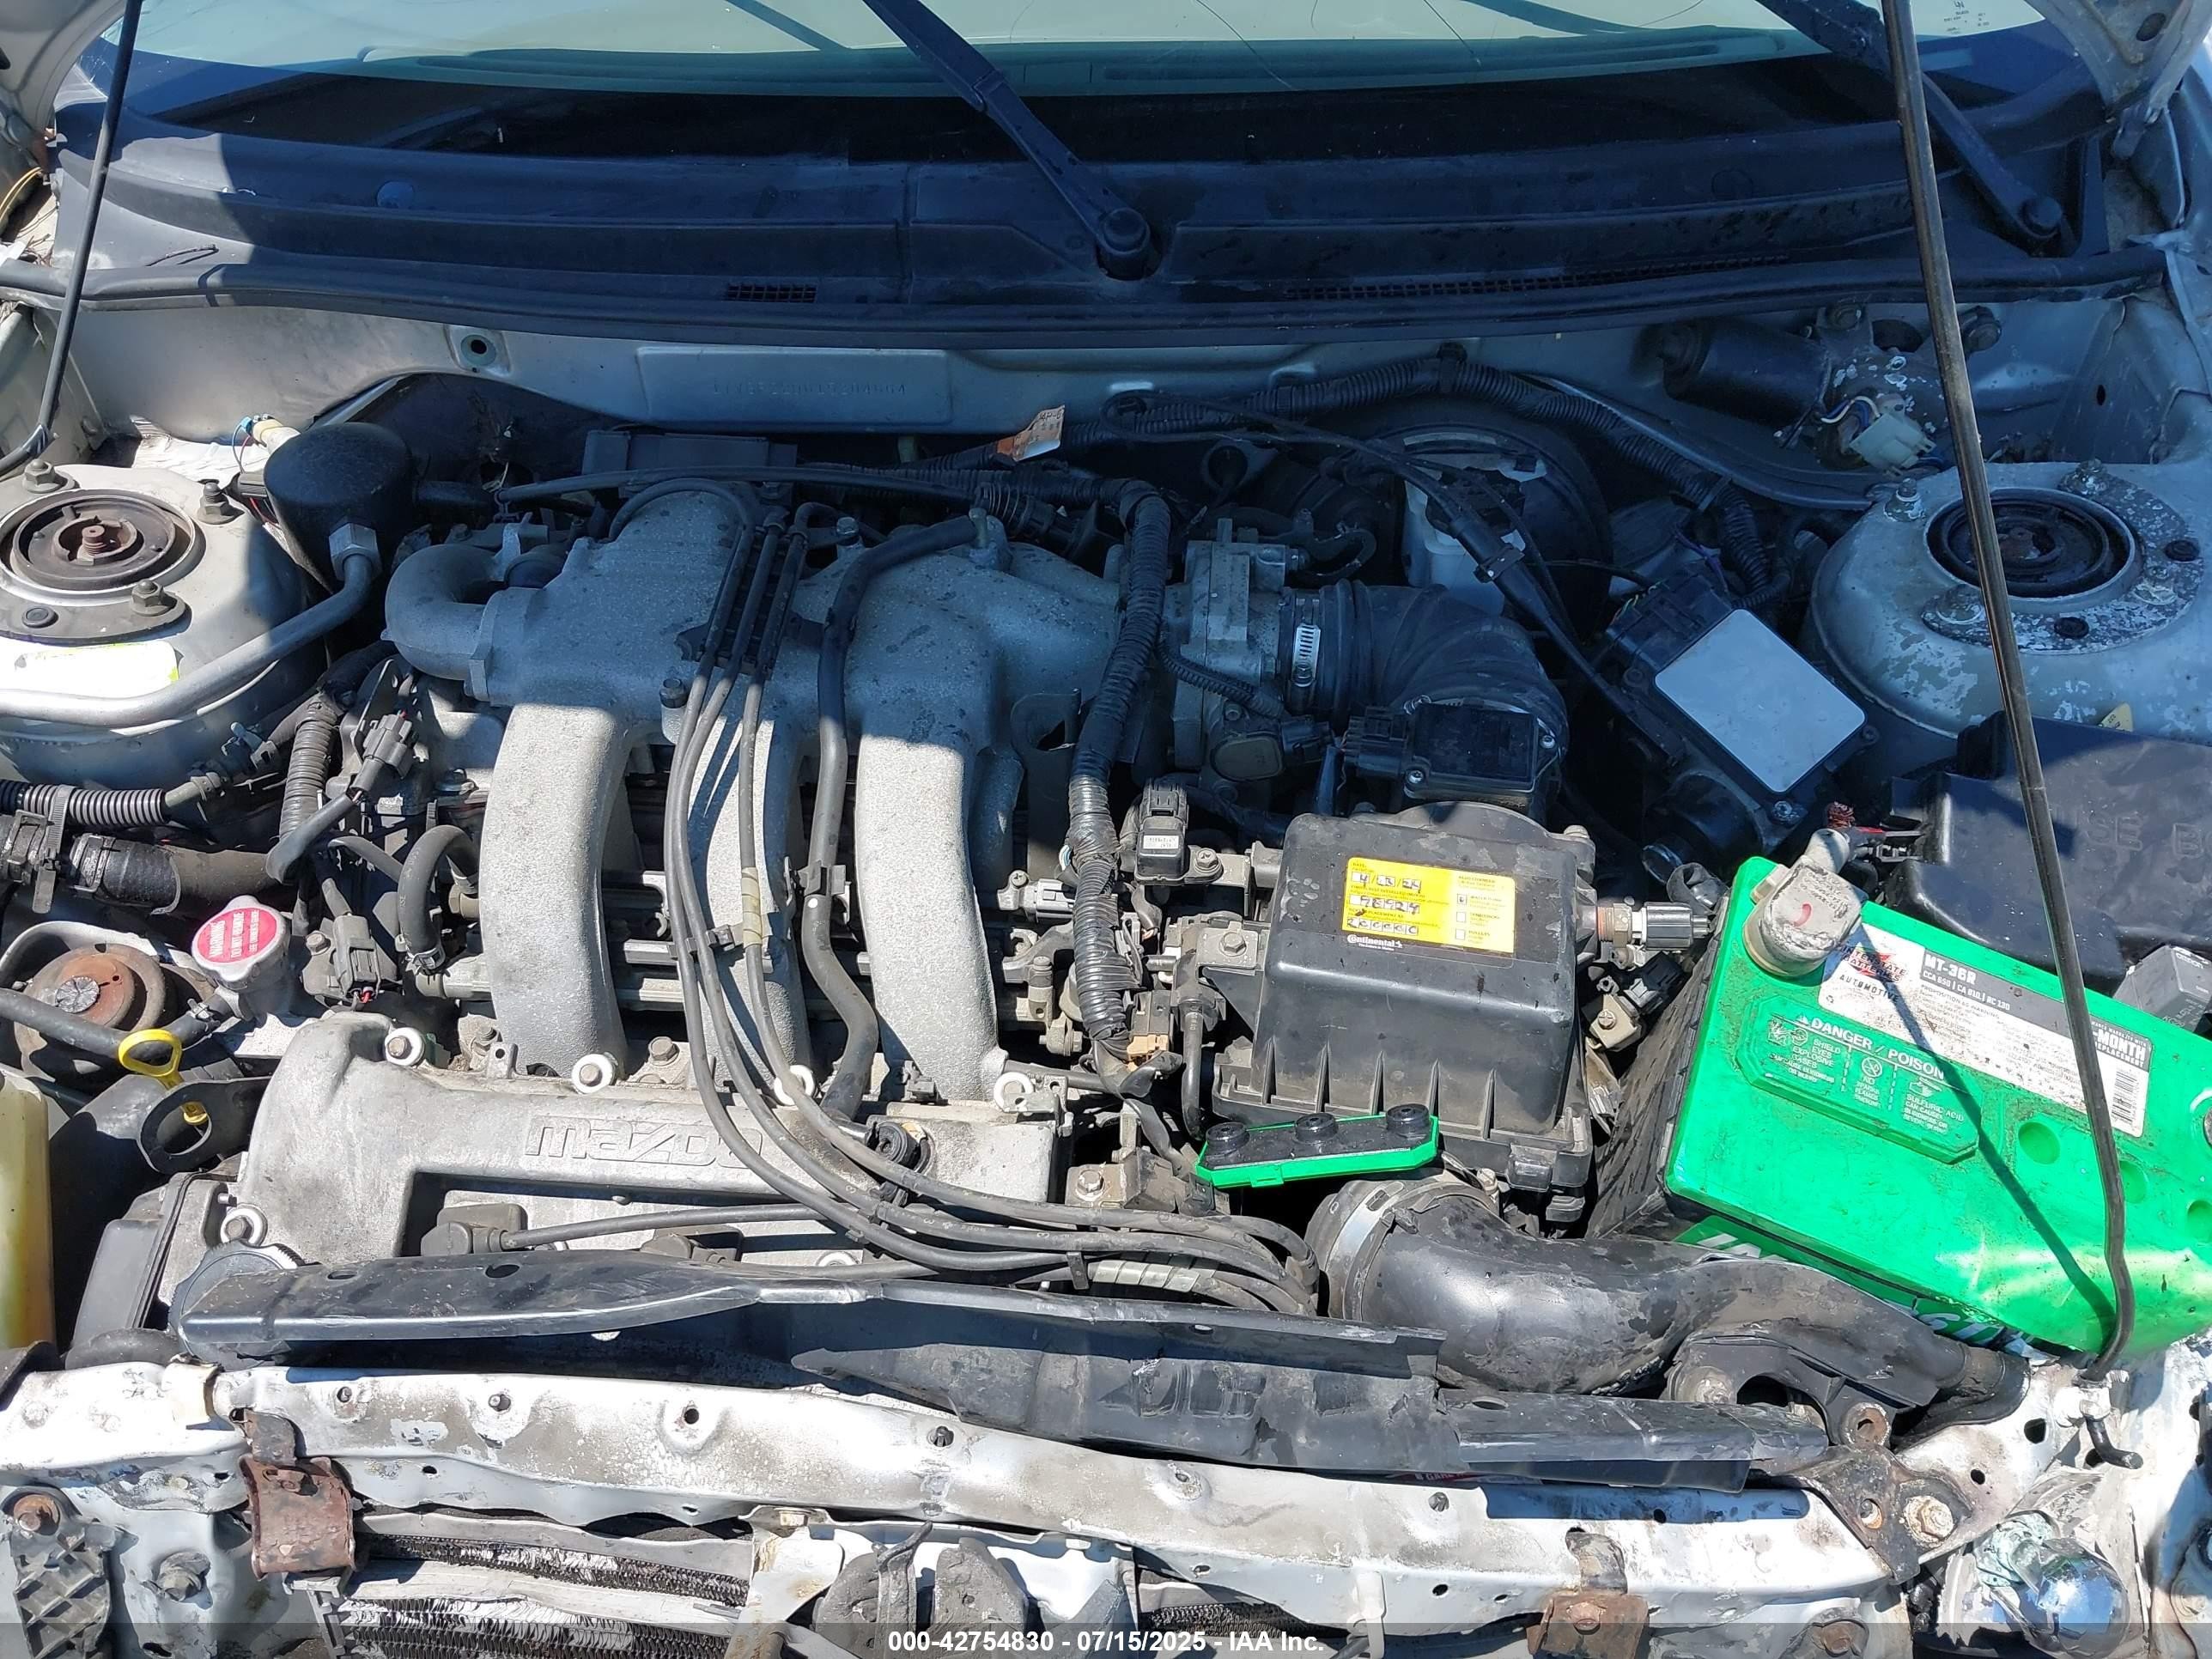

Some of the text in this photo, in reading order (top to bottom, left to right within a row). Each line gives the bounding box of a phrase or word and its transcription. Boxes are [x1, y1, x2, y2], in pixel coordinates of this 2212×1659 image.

[1842, 945, 1907, 977] INTERSTATE
[1844, 955, 1903, 982] BATTERIES
[1925, 953, 1977, 986] MT-36R
[1839, 975, 1900, 1003] AUTOMOTIVE
[1923, 970, 1936, 982] CCA
[1957, 984, 1966, 994] CA
[1986, 996, 1996, 1006] RC
[1792, 1046, 1835, 1067] EXPLOSIVE
[1811, 1018, 1874, 1051] DANGER
[1887, 1048, 1945, 1080] POISON
[1812, 1047, 1833, 1060] EYES
[1813, 1038, 1841, 1054] SHIELD
[2093, 1029, 2147, 1062] -MONTH
[1792, 1054, 1818, 1069] GASES
[1855, 1087, 1879, 1102] FLAMES
[1863, 1076, 1875, 1085] NO
[1906, 1093, 1965, 1122] SULFURIC ACID
[525, 1115, 763, 1169] mazda
